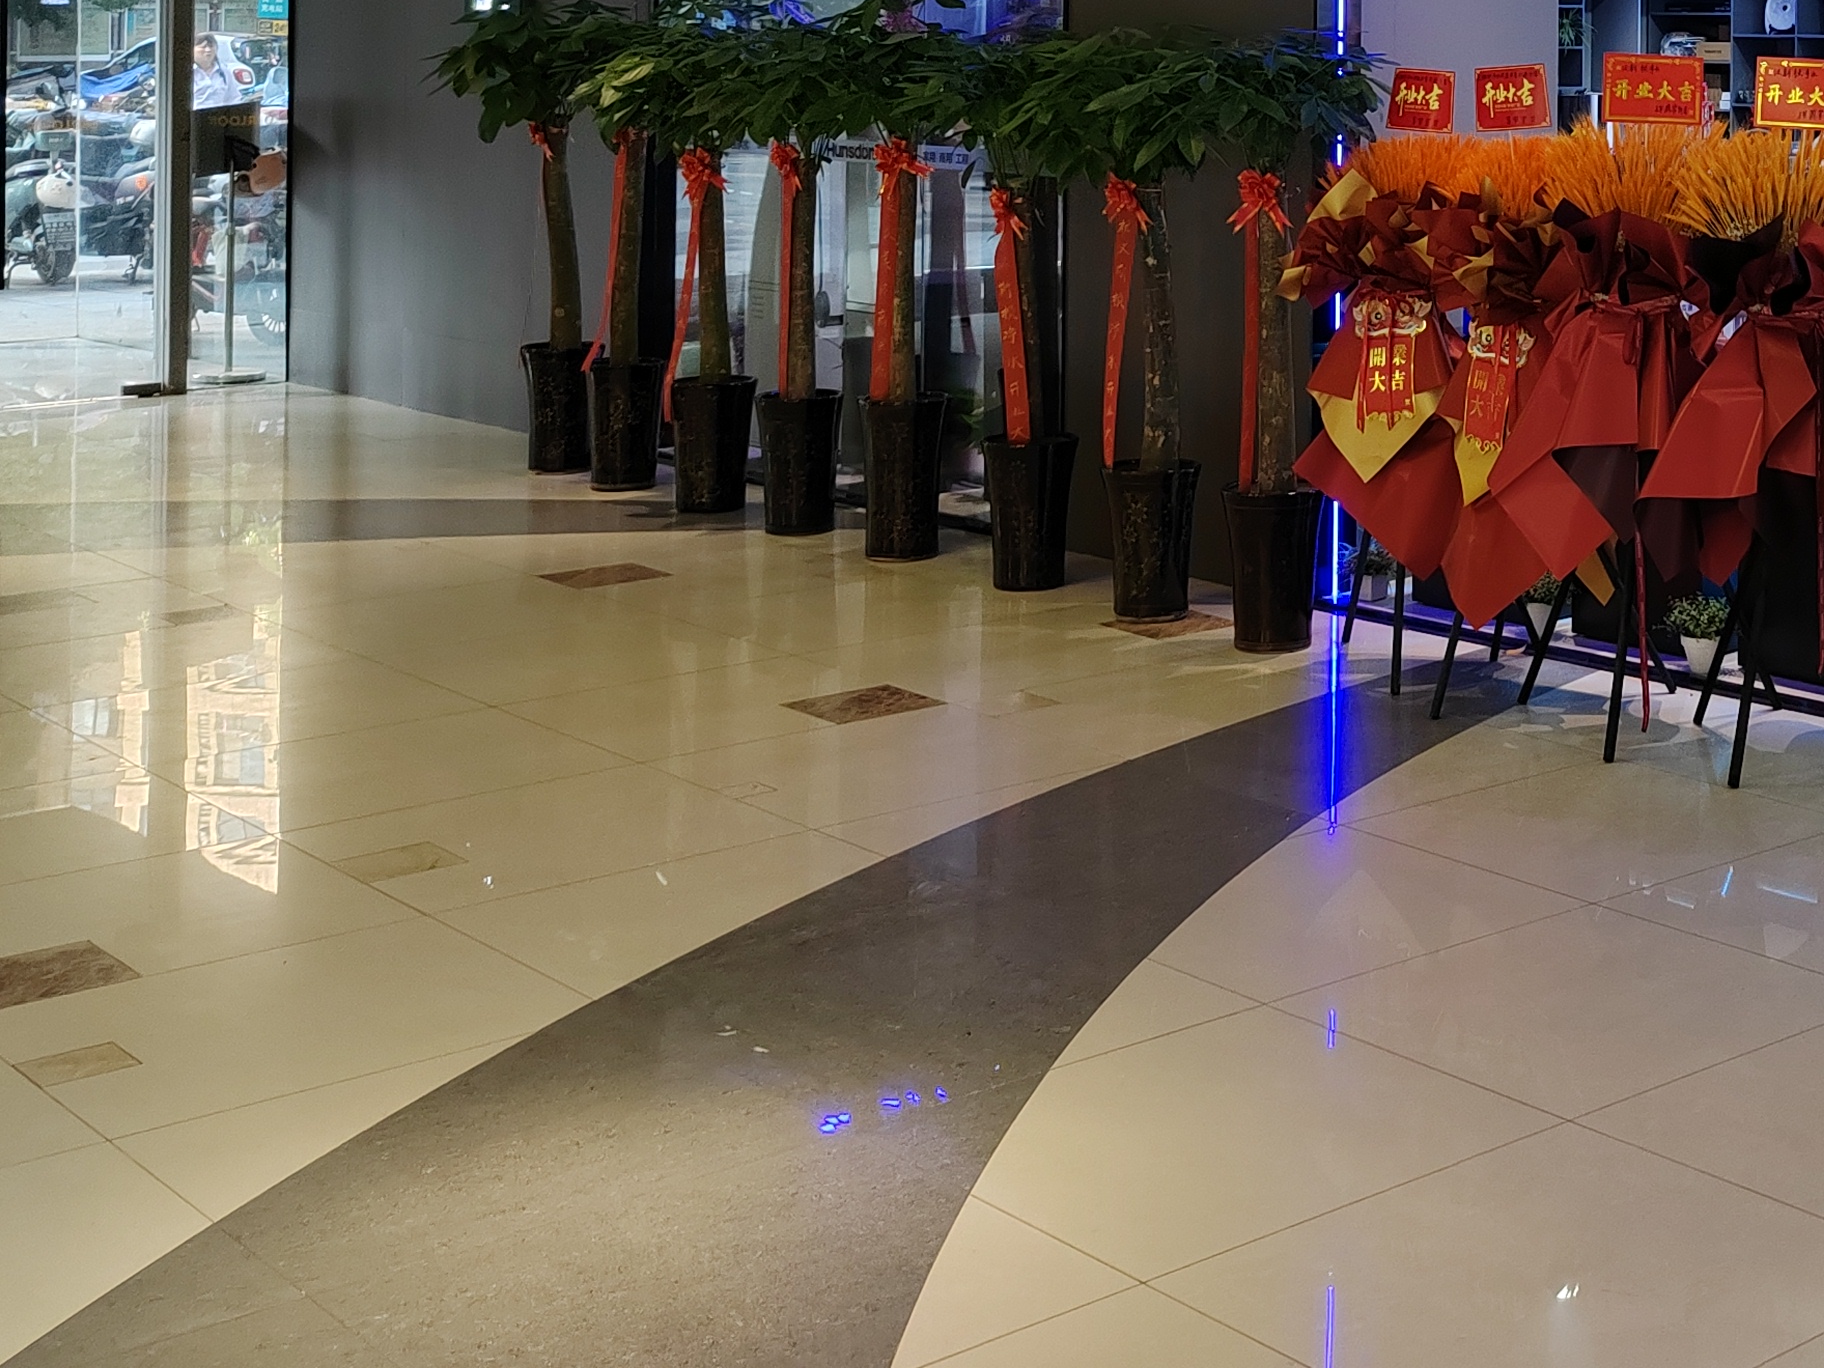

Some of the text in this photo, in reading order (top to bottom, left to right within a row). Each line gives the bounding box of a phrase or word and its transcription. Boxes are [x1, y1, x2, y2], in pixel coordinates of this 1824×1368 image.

[1395, 81, 1444, 117] 开业大吉
[1482, 77, 1535, 119] 开业大吉
[1611, 78, 1696, 103] 开业大吉
[1369, 369, 1406, 393] 大吉
